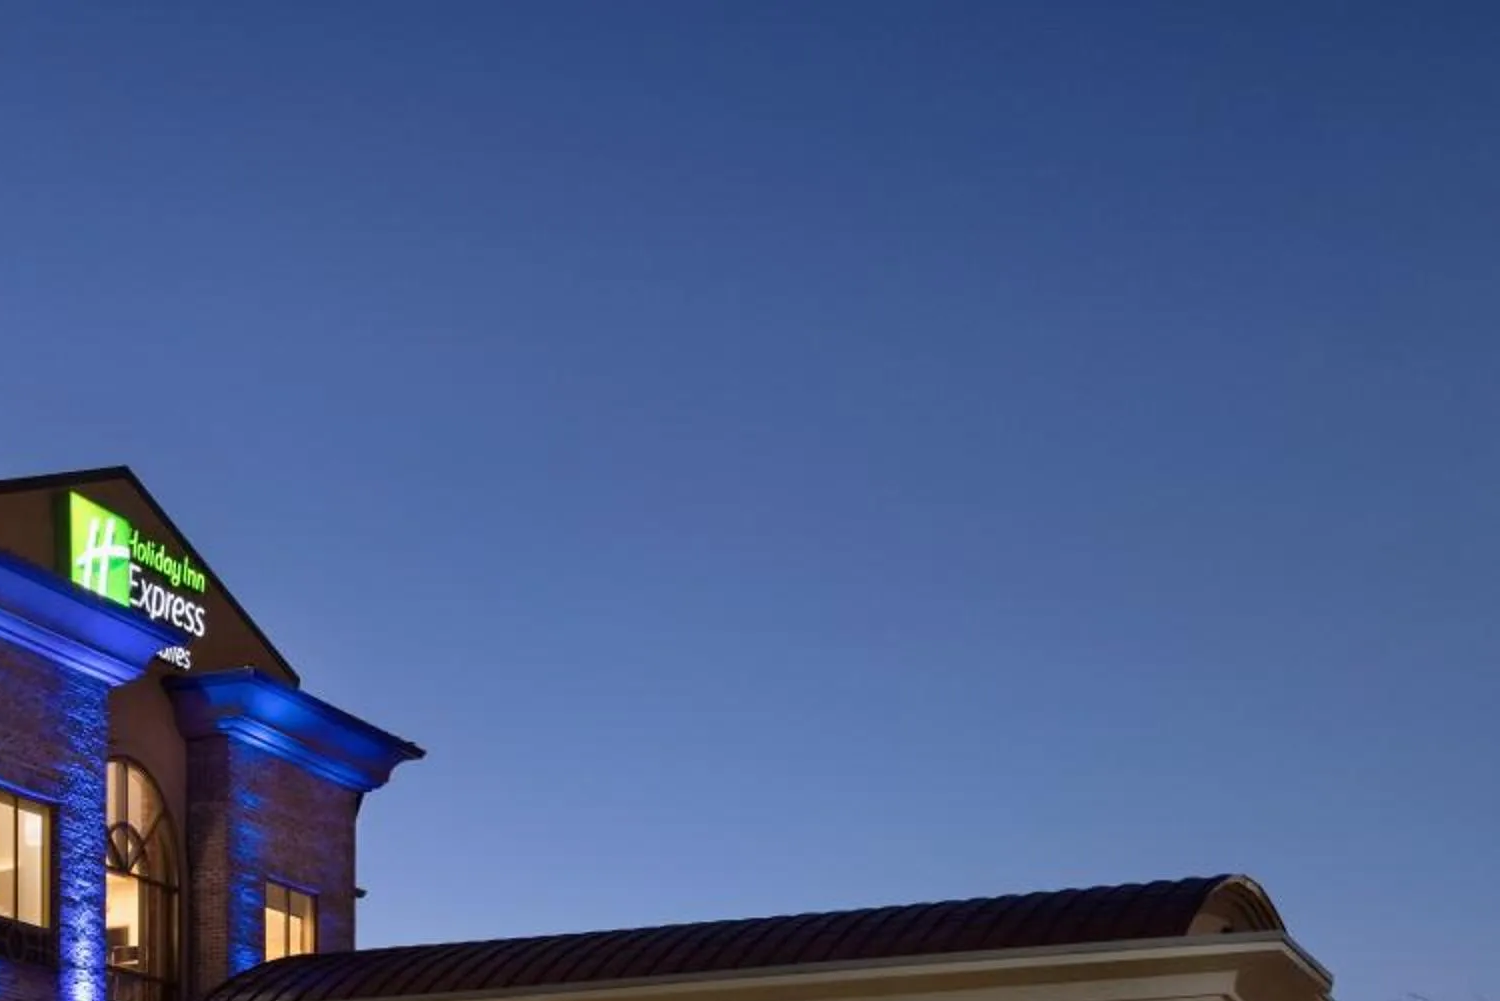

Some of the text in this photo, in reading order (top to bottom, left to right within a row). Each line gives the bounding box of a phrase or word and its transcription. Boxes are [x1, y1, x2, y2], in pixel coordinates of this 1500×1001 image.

[76, 516, 130, 597] H
[184, 556, 206, 593] Inn
[129, 561, 206, 637] Express
